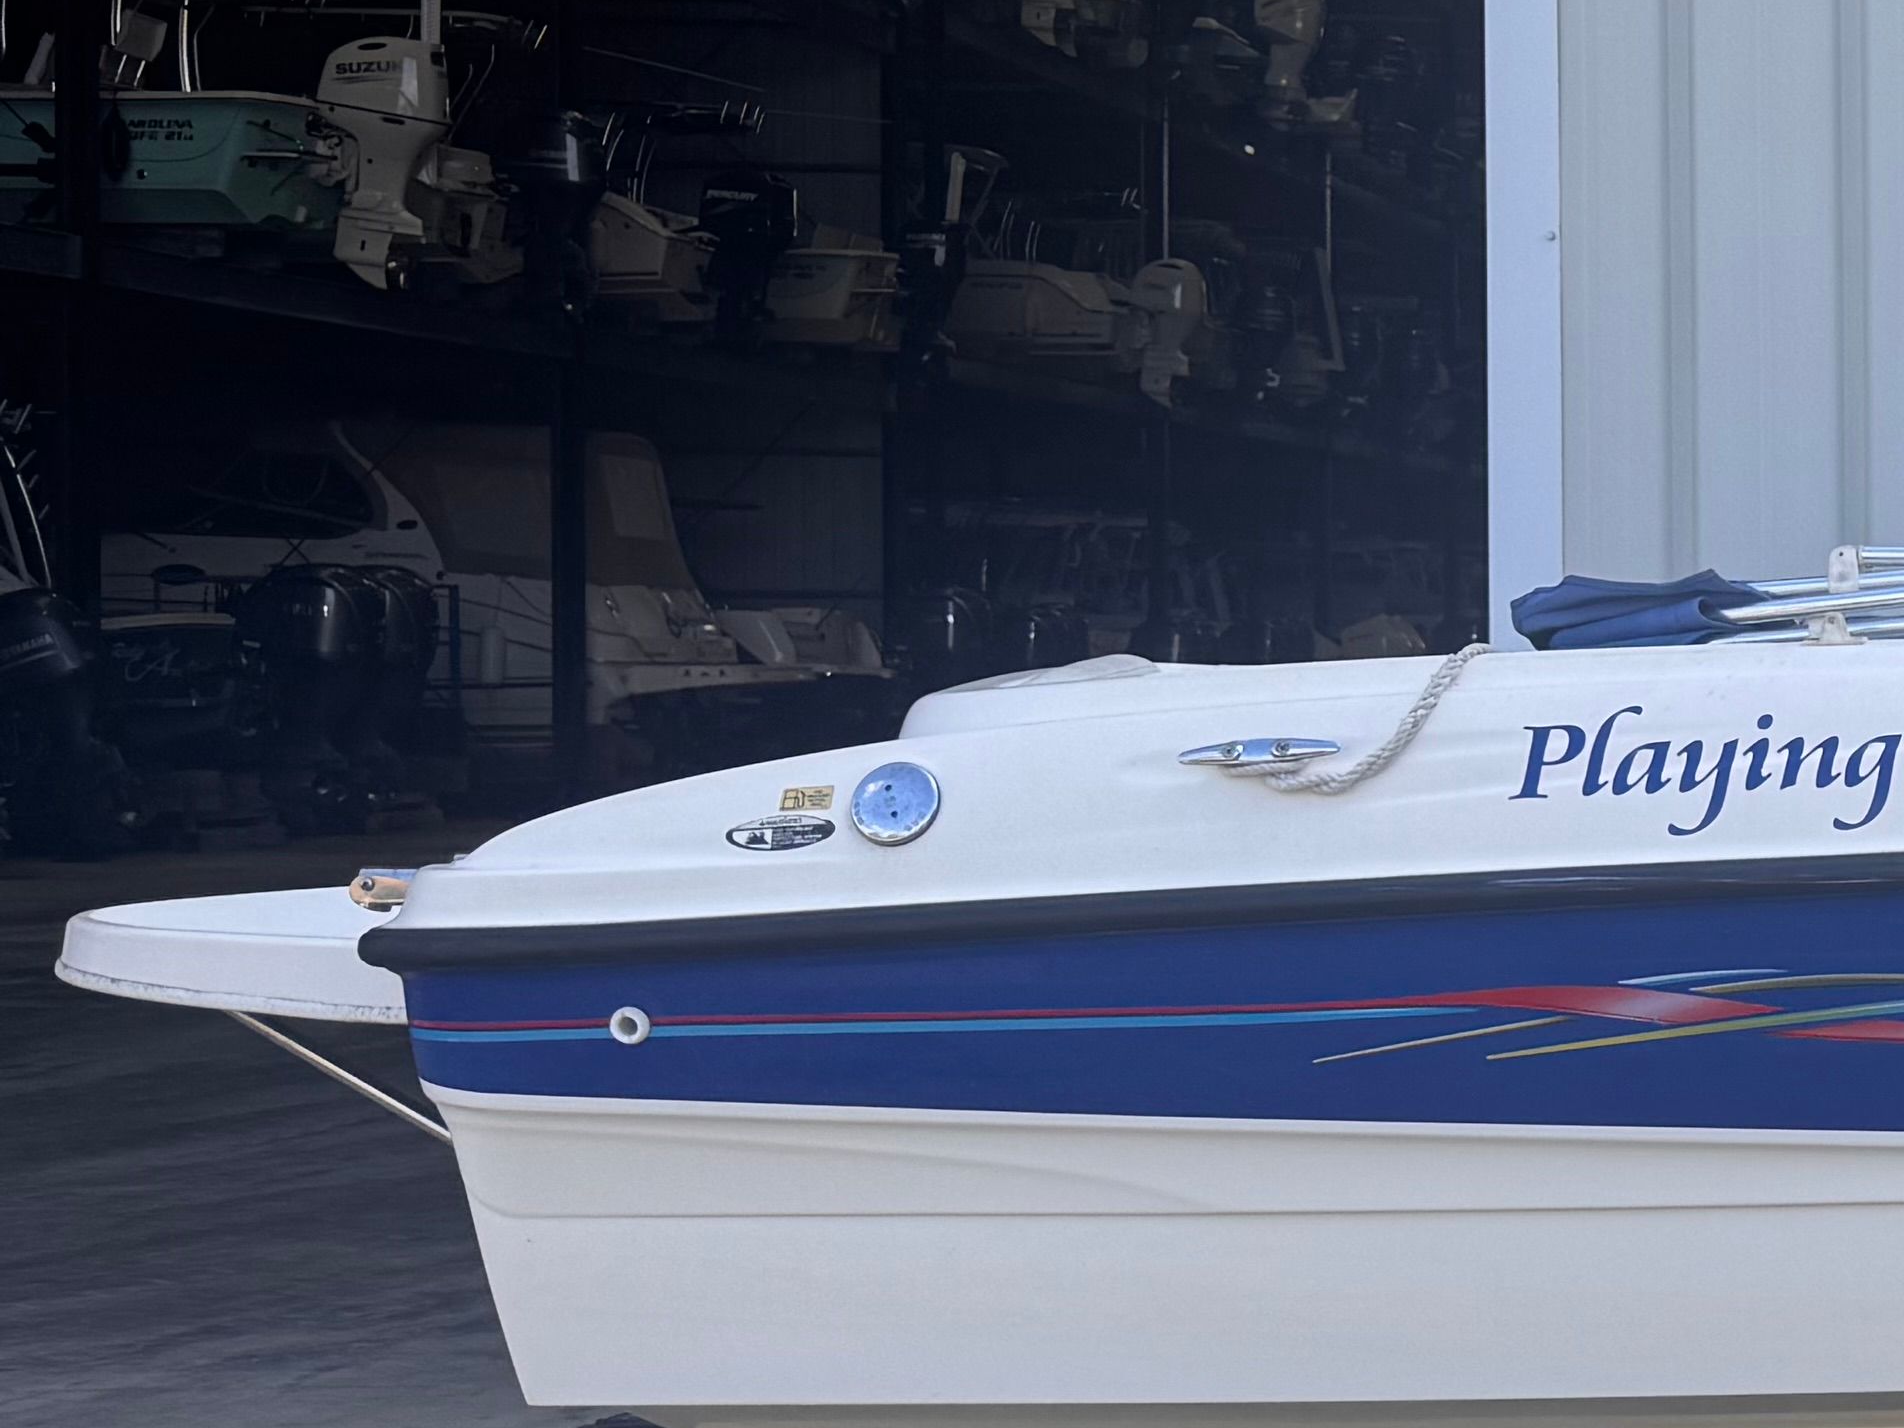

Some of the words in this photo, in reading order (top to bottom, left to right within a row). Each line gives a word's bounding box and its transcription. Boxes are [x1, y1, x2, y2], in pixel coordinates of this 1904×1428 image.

[335, 60, 405, 75] SUZUK
[127, 119, 194, 129] AROLINA
[1508, 705, 1903, 836] Playing
